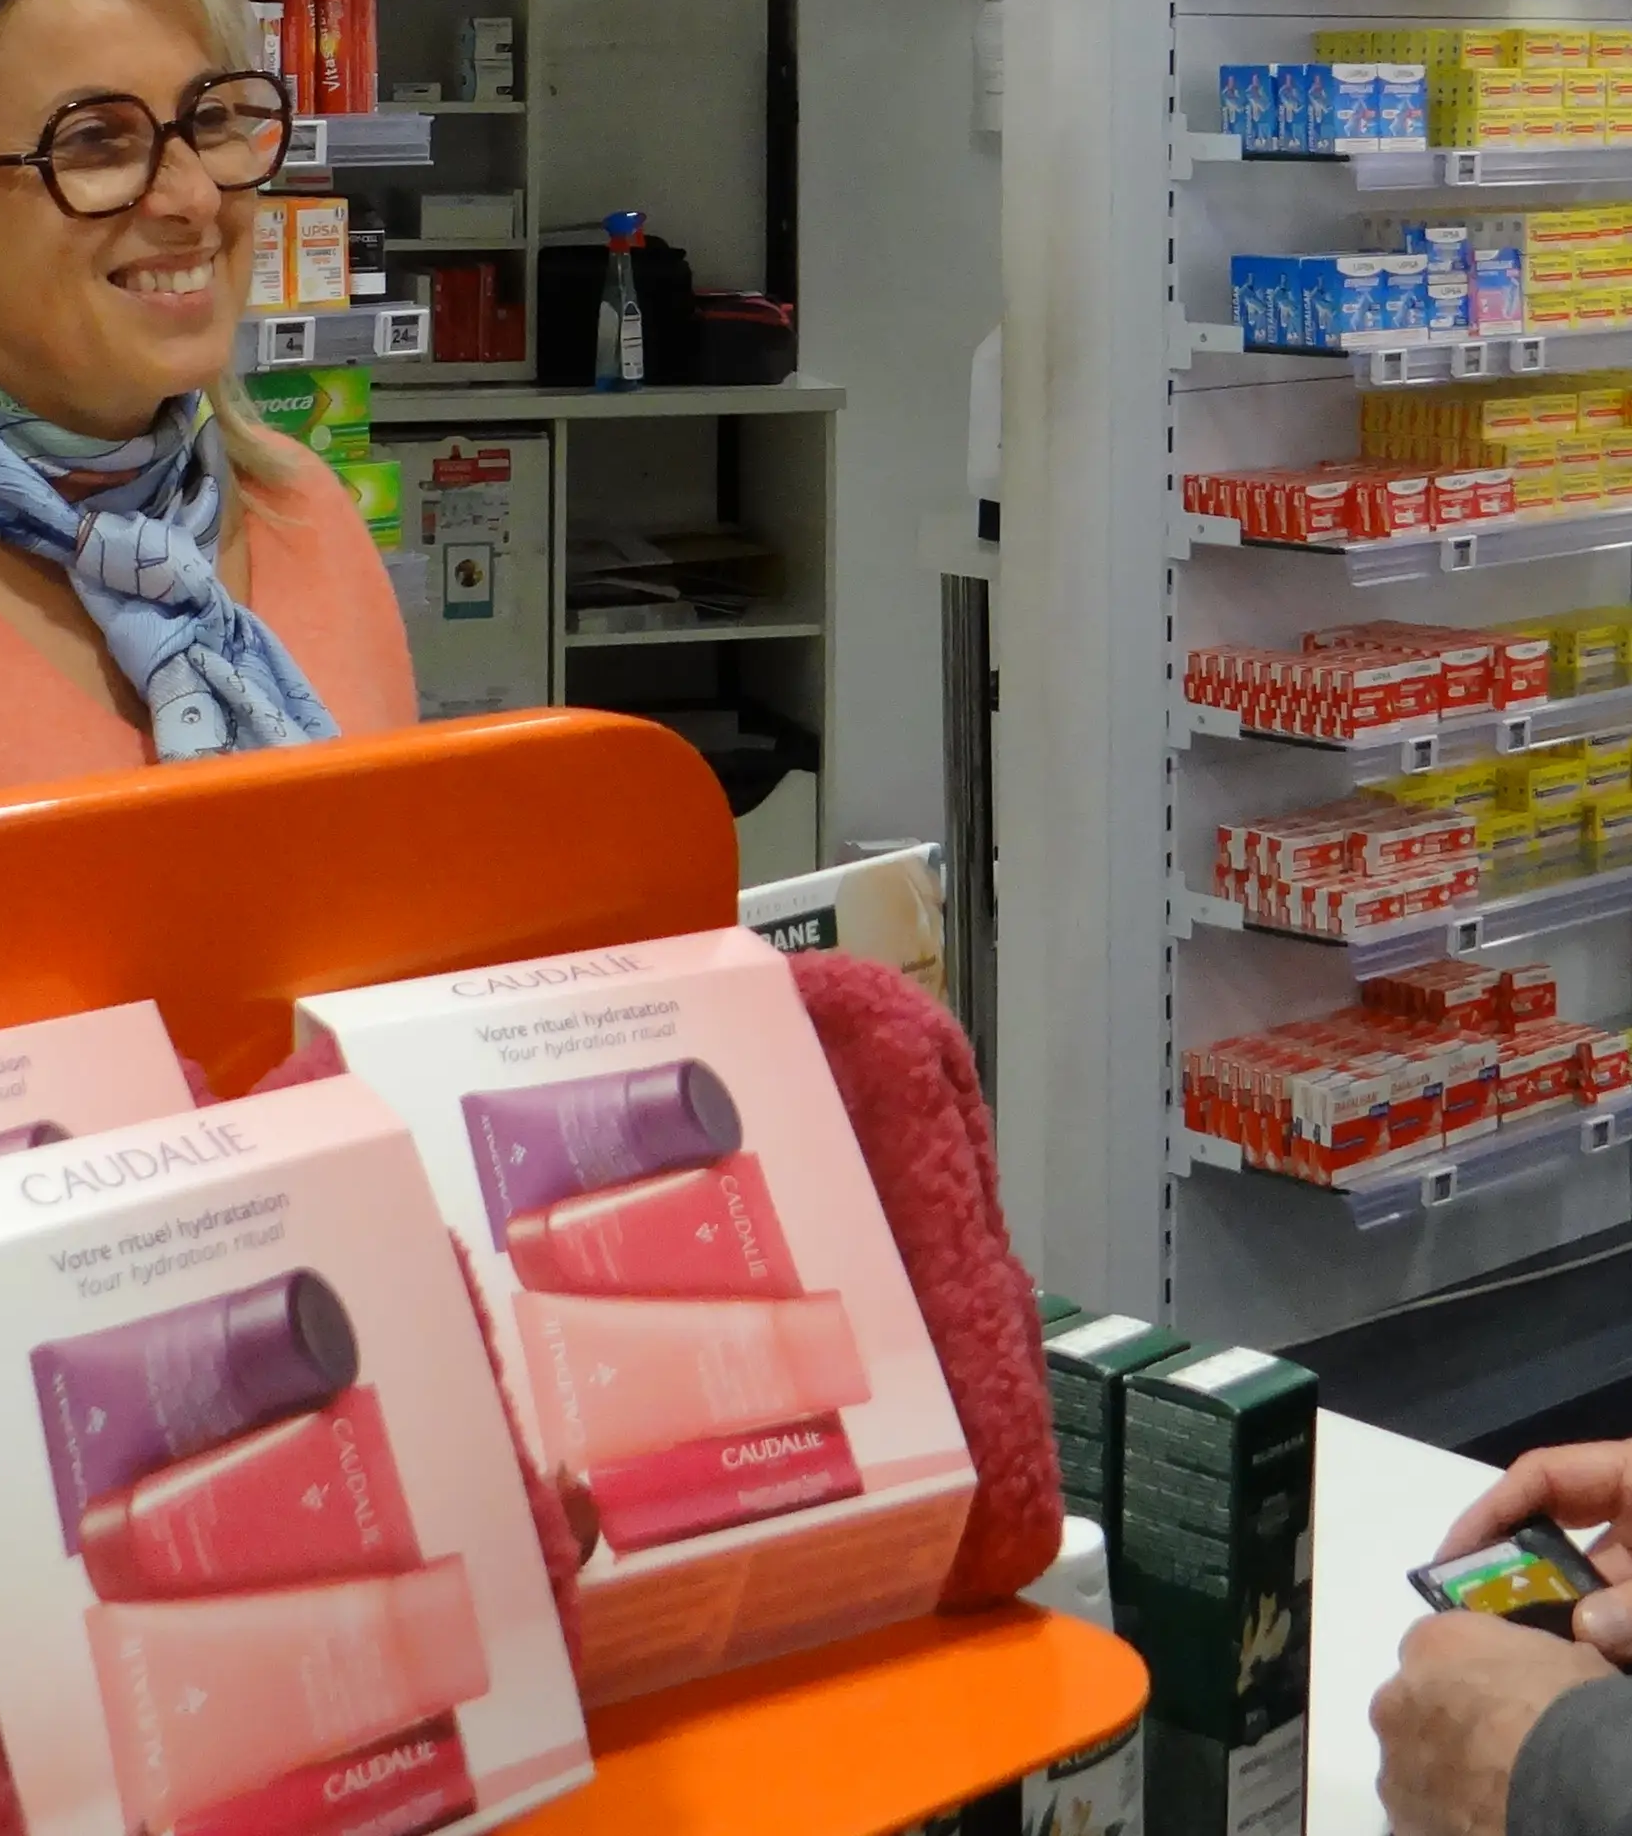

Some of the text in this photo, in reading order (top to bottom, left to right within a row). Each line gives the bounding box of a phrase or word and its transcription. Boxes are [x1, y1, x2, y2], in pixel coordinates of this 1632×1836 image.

[301, 224, 339, 238] UPSA
[476, 996, 680, 1046] Votre rituel hydratation
[498, 1018, 676, 1065] Your hydration ritual
[51, 1190, 290, 1274] Votre rituel hydratation
[75, 1220, 286, 1298] Your hydration ritual
